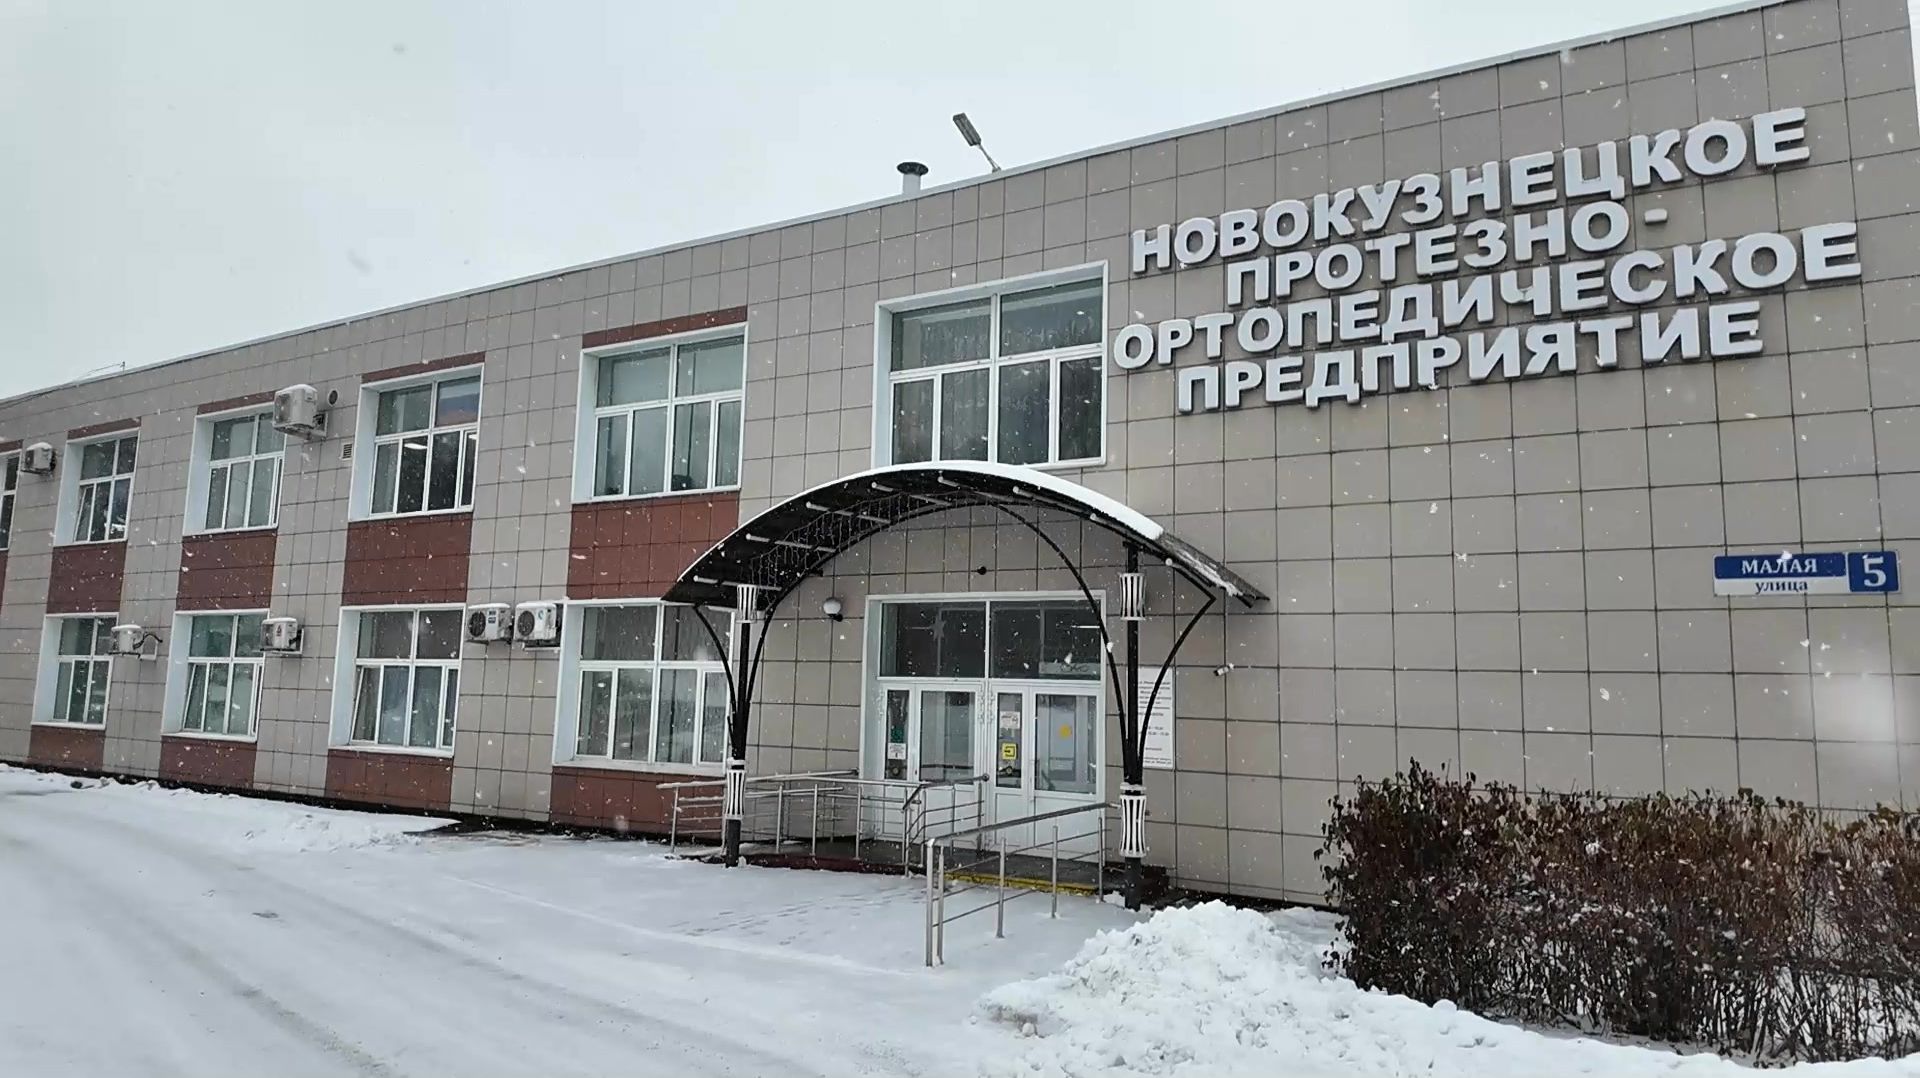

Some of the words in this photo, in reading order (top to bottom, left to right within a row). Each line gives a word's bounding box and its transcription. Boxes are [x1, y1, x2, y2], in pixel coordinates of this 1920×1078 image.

[1132, 108, 1810, 274] НОВОКУЗНЕЦКОЕ
[1113, 222, 1861, 370] ОРТОПЕДИЧЕСКОЕ
[1178, 302, 1763, 413] ПРЕДПРИЯТИЕ
[1741, 558, 1818, 575] МАЛАЯ
[1755, 581, 1808, 595] улица
[1863, 556, 1887, 587] 5
